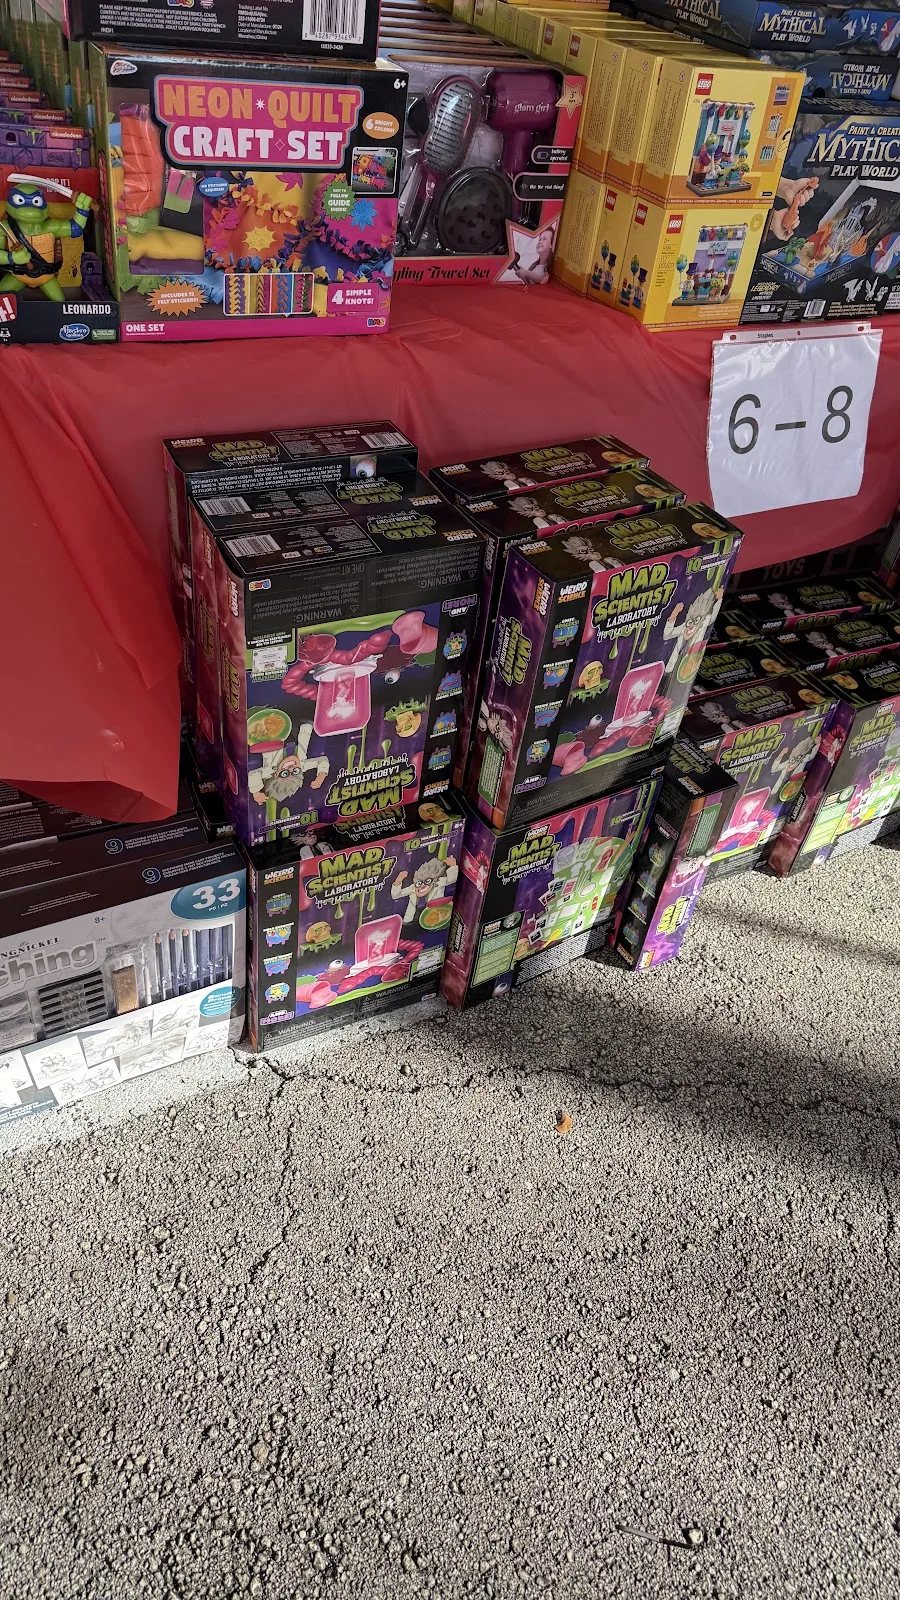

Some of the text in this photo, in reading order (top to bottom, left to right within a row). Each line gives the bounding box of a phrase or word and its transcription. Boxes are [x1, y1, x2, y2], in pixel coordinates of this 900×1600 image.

[689, 13, 709, 28] WORLD
[758, 13, 827, 35] MYTHICAL
[771, 32, 810, 43] PLAY WORLD
[843, 63, 881, 73] PLAY WORLD
[393, 78, 406, 89] 6+
[697, 80, 711, 89] LEGO
[829, 71, 892, 92] MYTHICAL
[163, 84, 356, 128] NEON QUILT
[514, 103, 550, 114] glam girl
[365, 118, 394, 130] 6 BRIGHT
[847, 126, 869, 136] PAINT
[51, 131, 82, 139] nickelodeon
[173, 125, 342, 161] CRAFT SET
[807, 132, 900, 163] MYTHIC
[830, 164, 899, 177] PLAY WORLD
[668, 219, 682, 228] LEGO
[427, 265, 468, 279] Travel
[470, 265, 490, 279] Set
[332, 288, 372, 304] 4 SIMPLE
[345, 297, 374, 305] KNOTS!
[63, 303, 111, 315] LEONARDO
[126, 323, 165, 332] ONE SET
[368, 317, 386, 327] RMS
[728, 393, 761, 455] 6
[822, 385, 853, 444] 8
[211, 446, 278, 460] SCIENTIST
[213, 440, 263, 452] MAD
[523, 447, 570, 463] MAD
[526, 452, 592, 472] SCIENTIST
[546, 460, 585, 474] LABORATORY
[338, 484, 401, 499] SCIENTIST
[354, 491, 399, 504] MAD
[553, 481, 600, 498] MAD
[557, 486, 625, 507] SCIENTIST
[466, 500, 494, 509] WEIRD
[578, 494, 618, 508] LABORATORY
[370, 517, 434, 534] SCIENTIST
[385, 525, 434, 541] MAD
[606, 519, 652, 538] MAD
[447, 532, 477, 542] WEIRD
[610, 525, 680, 551] SCIENTIST
[634, 534, 675, 551] LABORATORY
[519, 540, 548, 552] WEIRD
[523, 545, 553, 556] SCIENCE
[687, 557, 703, 574] 10
[763, 561, 805, 581] TOYS
[417, 573, 462, 588] WARNING:
[610, 563, 668, 599] MAD
[532, 576, 545, 611] SCIENCE
[558, 591, 586, 604] SCIENCE
[560, 581, 588, 598] WEIRD
[799, 585, 835, 596] MAD
[231, 580, 239, 616] WEIRD
[444, 597, 477, 610] MORE!
[540, 582, 551, 616] WEIRD
[593, 582, 676, 622] SCIENTIST
[292, 607, 342, 623] WARNING:
[451, 607, 466, 615] AND
[606, 604, 659, 628] LABORATORY
[837, 621, 872, 633] MAD
[500, 626, 511, 668] LABORATORY
[501, 619, 520, 683] SCIENTIST
[513, 635, 532, 682] MAD
[703, 653, 736, 667] MAD
[837, 653, 879, 671] MAD
[701, 659, 749, 677] SCIENTIST
[732, 686, 772, 702] MAD
[737, 692, 790, 712] SCIENTIST
[862, 714, 896, 735] MAD
[734, 724, 781, 749] MAD
[851, 723, 898, 746] SCIENTIST
[721, 734, 785, 763] SCIENTIST
[858, 736, 888, 751] LABORATORY
[729, 750, 770, 767] LABORATORY
[344, 766, 400, 786] LABORATORY
[424, 778, 450, 790] SCIENCE
[525, 776, 540, 785] AND
[326, 769, 414, 804] SCIENTIST
[424, 784, 449, 797] WEIRD
[341, 786, 400, 815] MAD
[301, 812, 317, 824] 10
[353, 817, 397, 833] LABORATORY
[611, 817, 621, 827] 10
[527, 826, 549, 837] WEIRD
[105, 838, 123, 855] 9
[405, 839, 421, 852] 10
[510, 836, 553, 860] MAD
[321, 848, 382, 878] MAD
[499, 845, 560, 875] SCIENTIST
[509, 858, 549, 876] LABORATORY
[142, 867, 161, 884] 9
[264, 873, 294, 886] SCIENCE
[265, 867, 295, 880] WEIRD
[309, 858, 395, 896] SCIENTIST
[192, 878, 241, 910] 33
[324, 876, 379, 897] LABORATORY
[95, 916, 106, 924] 8+
